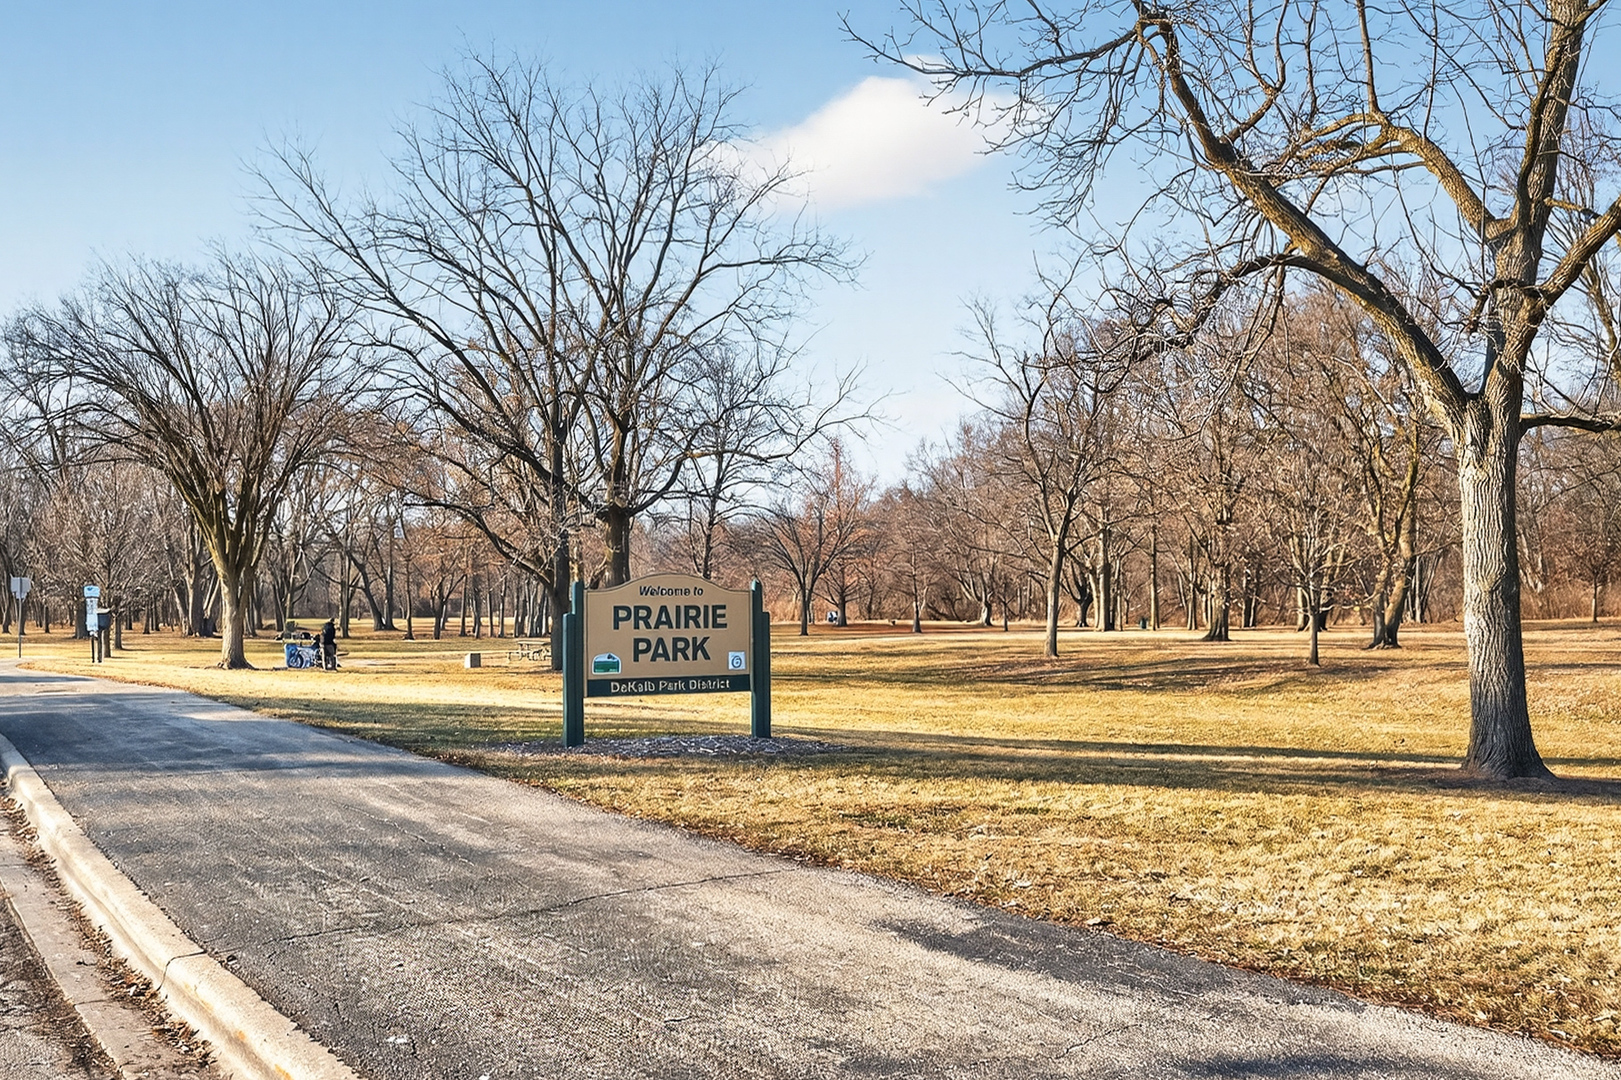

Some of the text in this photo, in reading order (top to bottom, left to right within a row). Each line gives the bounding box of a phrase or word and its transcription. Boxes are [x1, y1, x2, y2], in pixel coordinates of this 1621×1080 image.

[639, 585, 704, 596] Welcome to
[613, 605, 727, 630] PRAIRIE
[633, 636, 711, 662] PARK
[610, 678, 730, 693] DeKalb Park District
